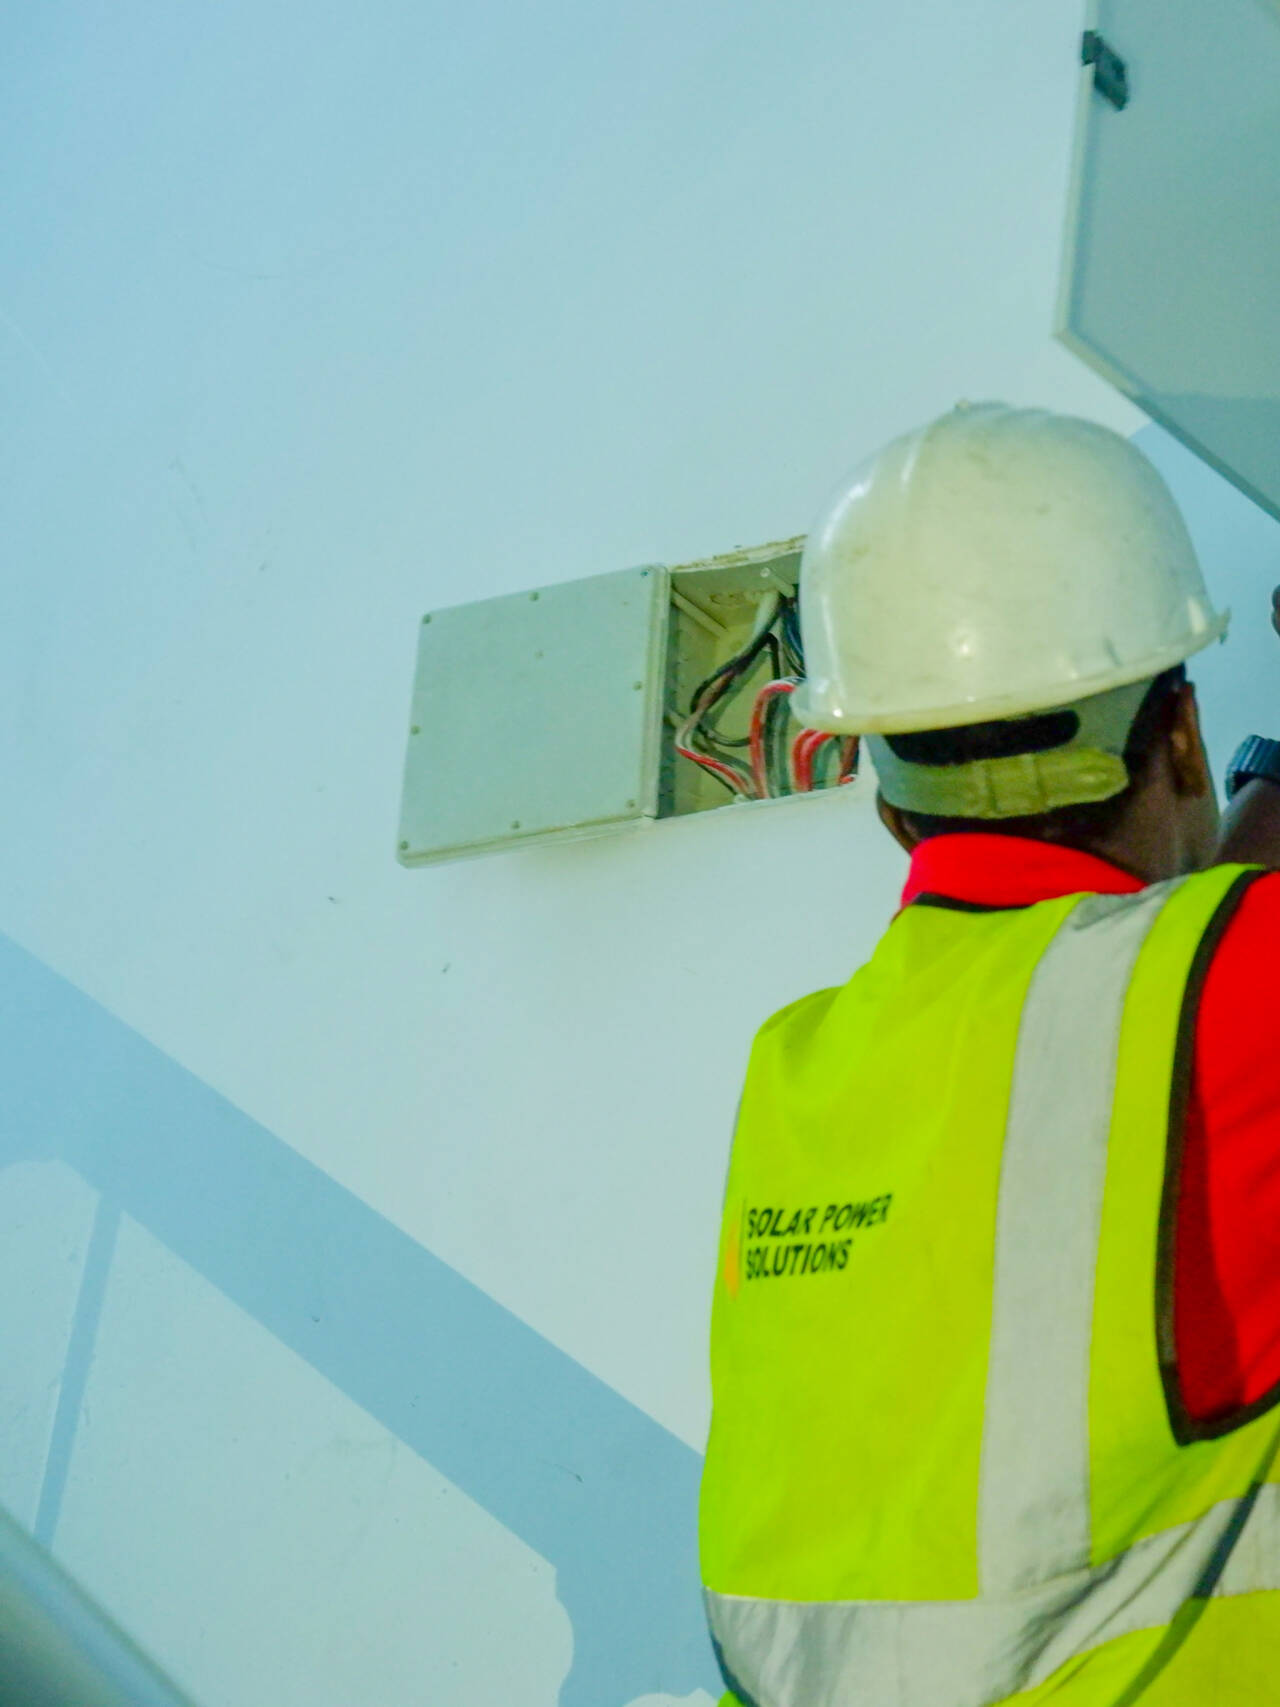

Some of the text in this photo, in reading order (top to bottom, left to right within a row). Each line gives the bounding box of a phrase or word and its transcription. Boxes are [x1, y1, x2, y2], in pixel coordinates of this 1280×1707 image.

[748, 1193, 892, 1239] SOLAR POWER
[746, 1238, 852, 1281] SOLUTIONS
